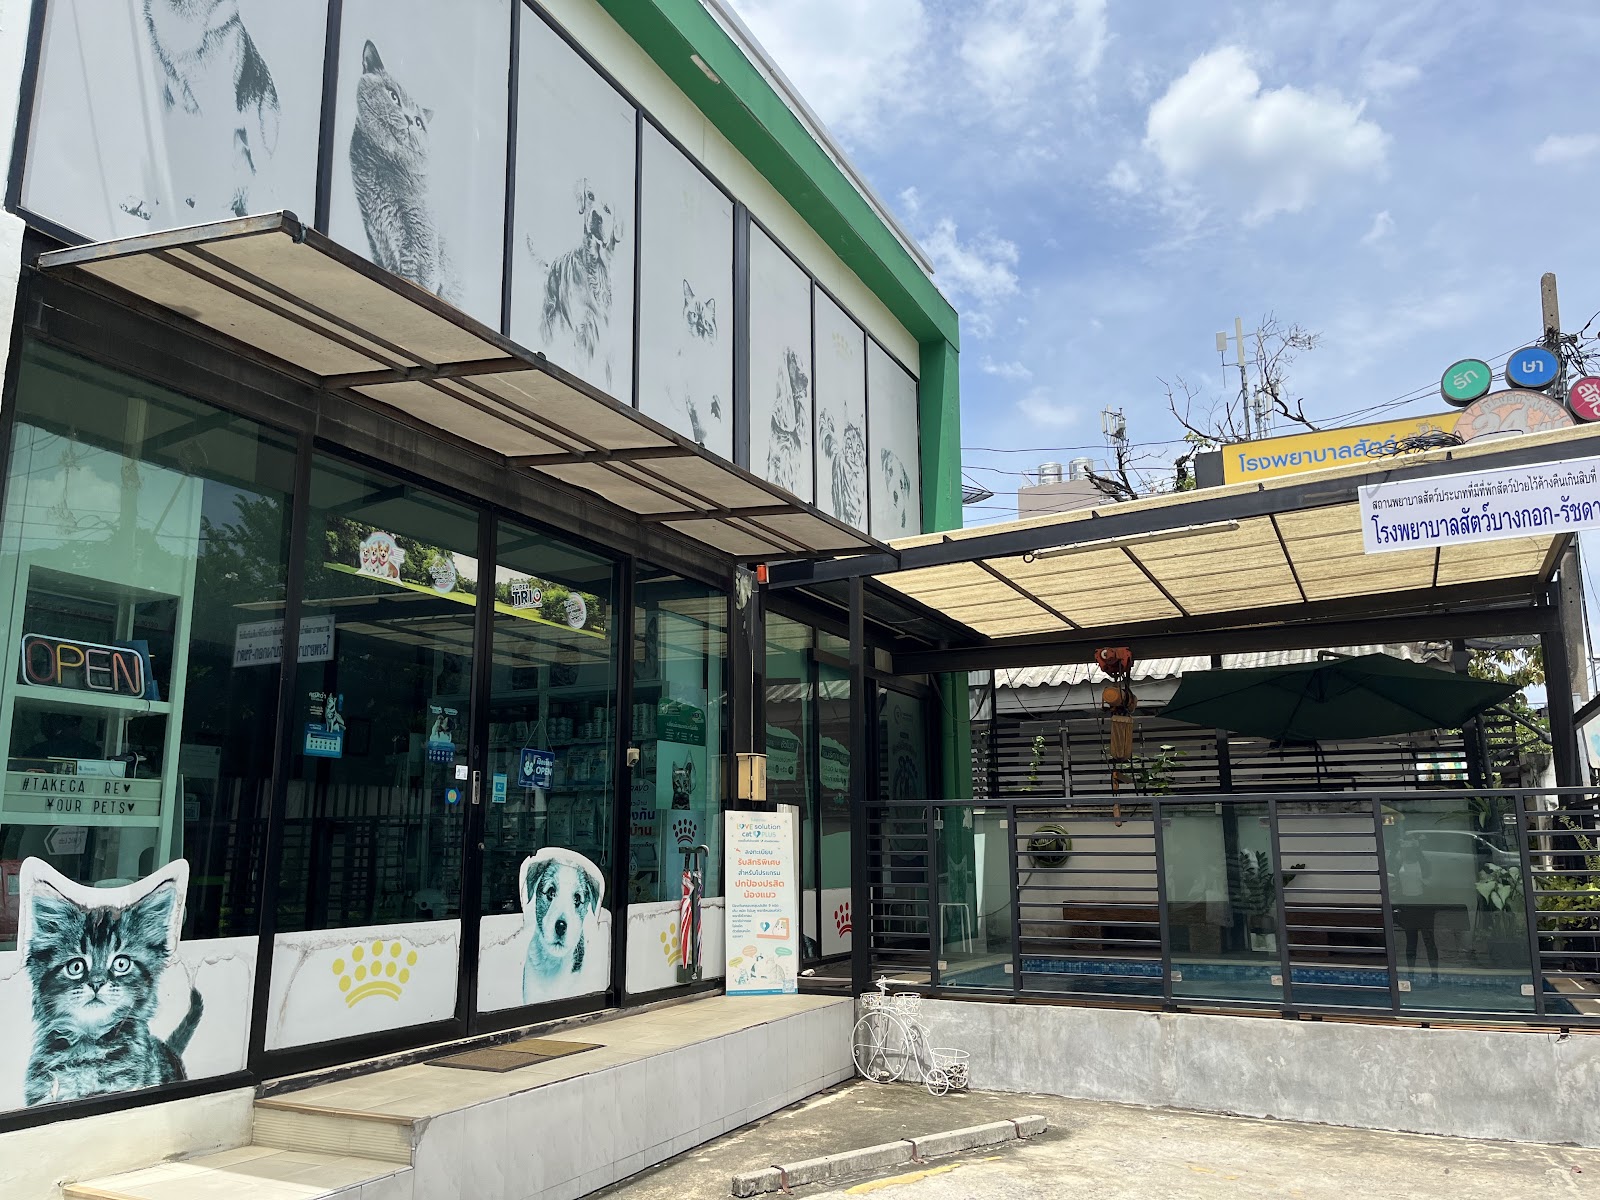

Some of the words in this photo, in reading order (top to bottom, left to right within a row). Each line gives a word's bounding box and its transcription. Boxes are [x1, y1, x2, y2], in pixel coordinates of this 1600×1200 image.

[1522, 360, 1544, 374] ษา
[1453, 369, 1479, 390] รัก
[1238, 434, 1397, 473] โรงพยาบาลสัตว์
[511, 583, 529, 592] SUPER
[511, 587, 542, 605] TRIO
[26, 639, 141, 694] OPEN
[535, 766, 553, 776] OPEN
[93, 799, 125, 814] PETS
[735, 879, 785, 888] ปกป้องปรสิต
[744, 890, 776, 898] น้องแมว
